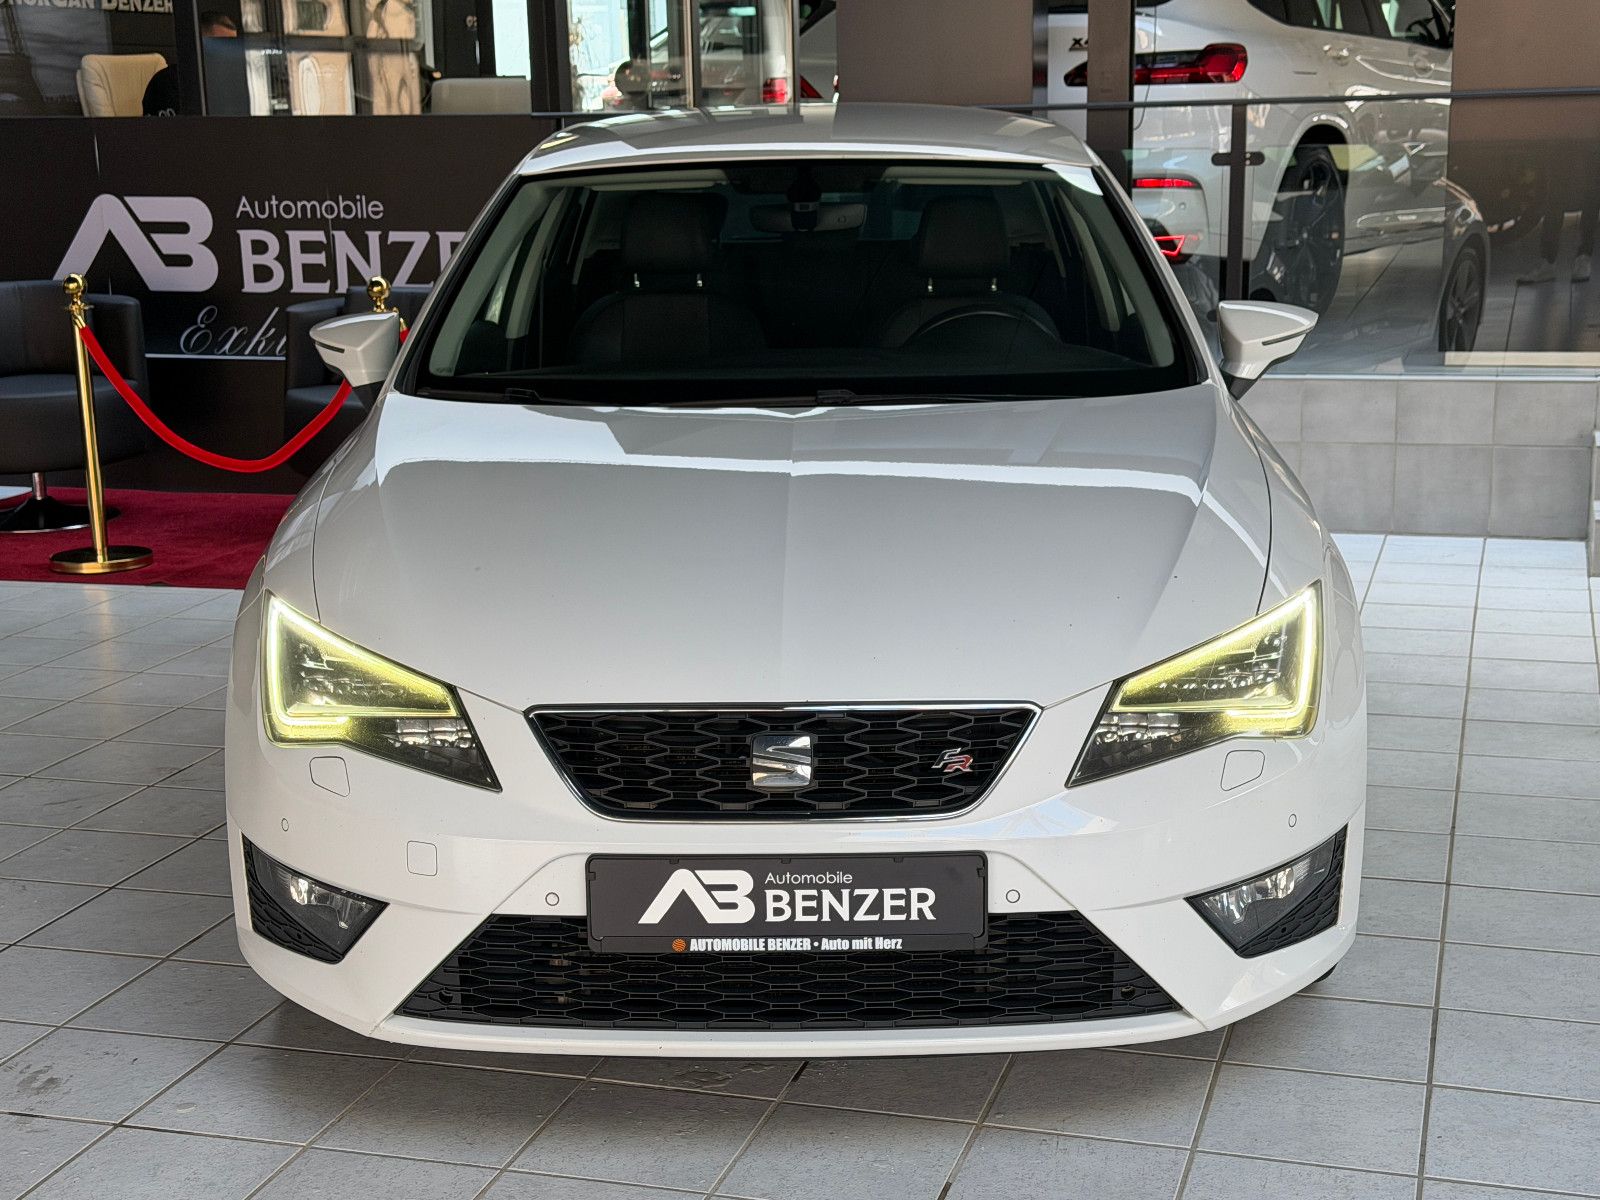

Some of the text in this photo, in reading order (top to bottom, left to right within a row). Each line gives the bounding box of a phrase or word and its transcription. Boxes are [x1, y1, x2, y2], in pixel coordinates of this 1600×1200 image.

[236, 195, 384, 219] Automobile
[53, 193, 219, 292] AB
[931, 747, 974, 772] FR
[765, 871, 853, 885] Automobile
[638, 868, 756, 924] AB
[765, 887, 937, 922] BENZER
[689, 936, 903, 952] AUTOMOBILE BENZER Auto mit Herz
